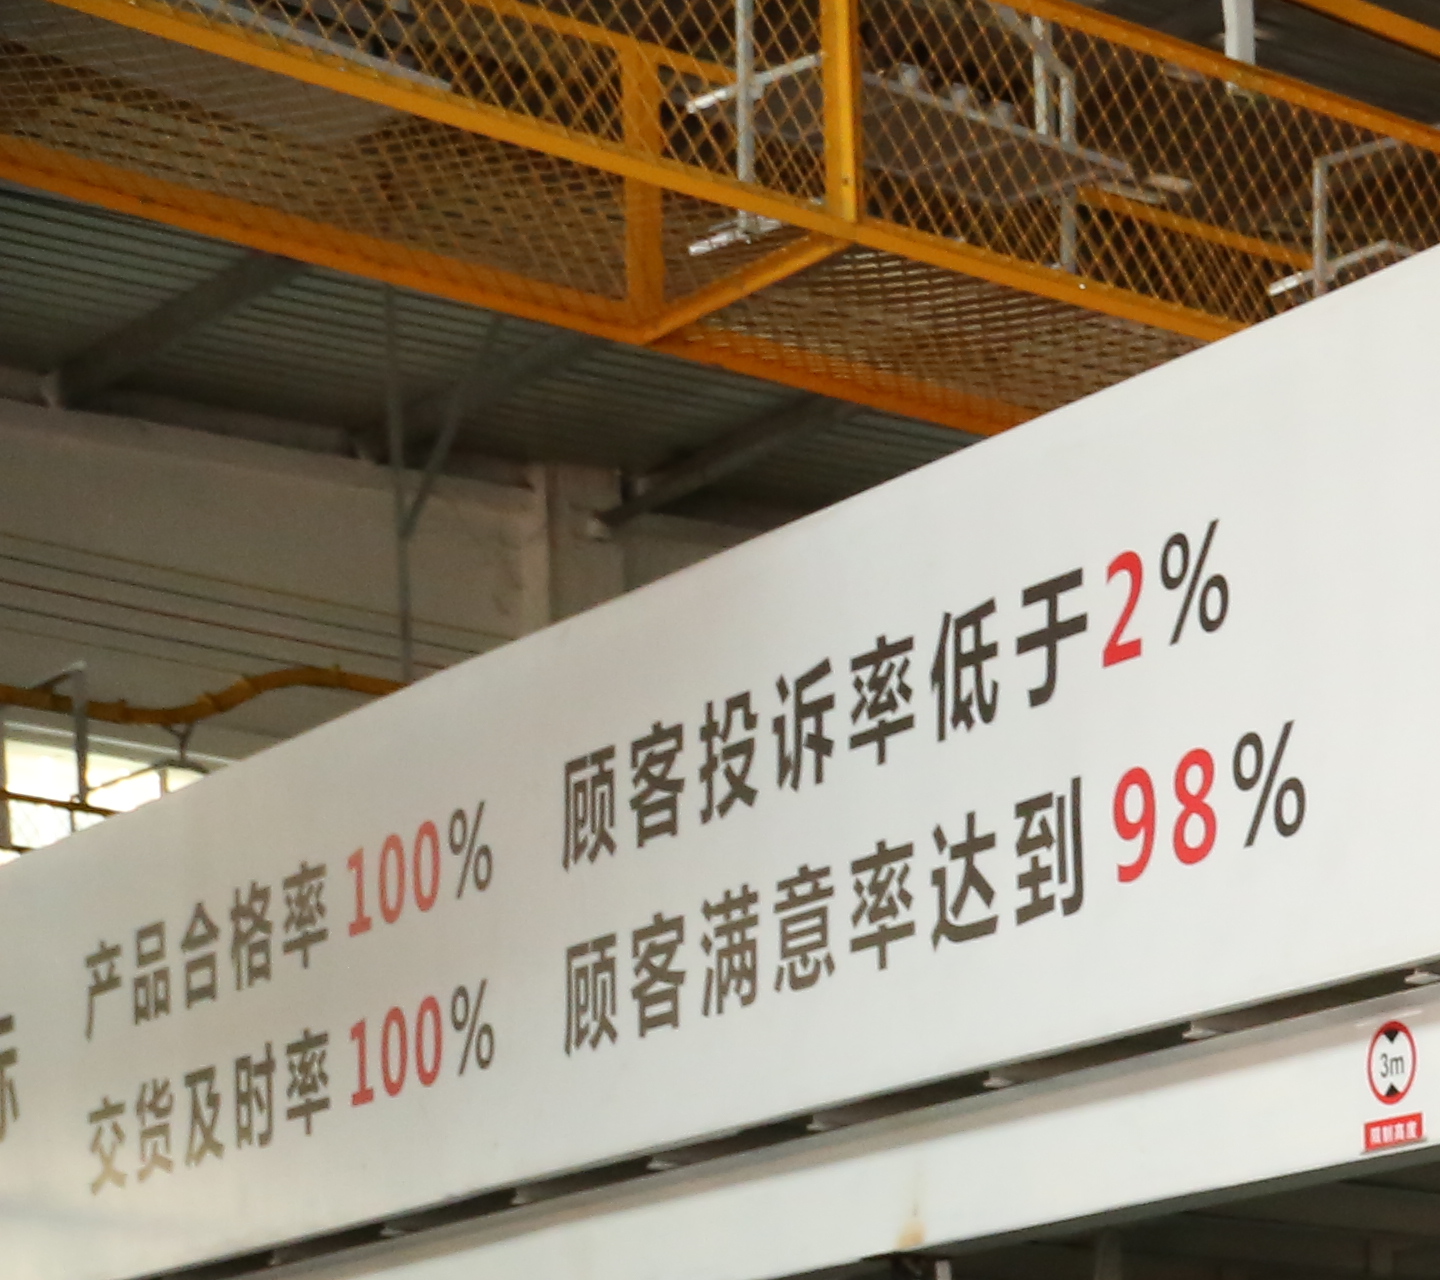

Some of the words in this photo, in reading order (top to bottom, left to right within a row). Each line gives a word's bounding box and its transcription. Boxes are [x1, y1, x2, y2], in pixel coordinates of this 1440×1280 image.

[562, 520, 1230, 872] 顾客投诉率低于2%
[83, 802, 494, 1040] 产品合格率100%
[562, 721, 1307, 1056] 顾客满意率达到98%
[88, 979, 496, 1195] 交货及时率100%
[1380, 1052, 1405, 1077] 3m
